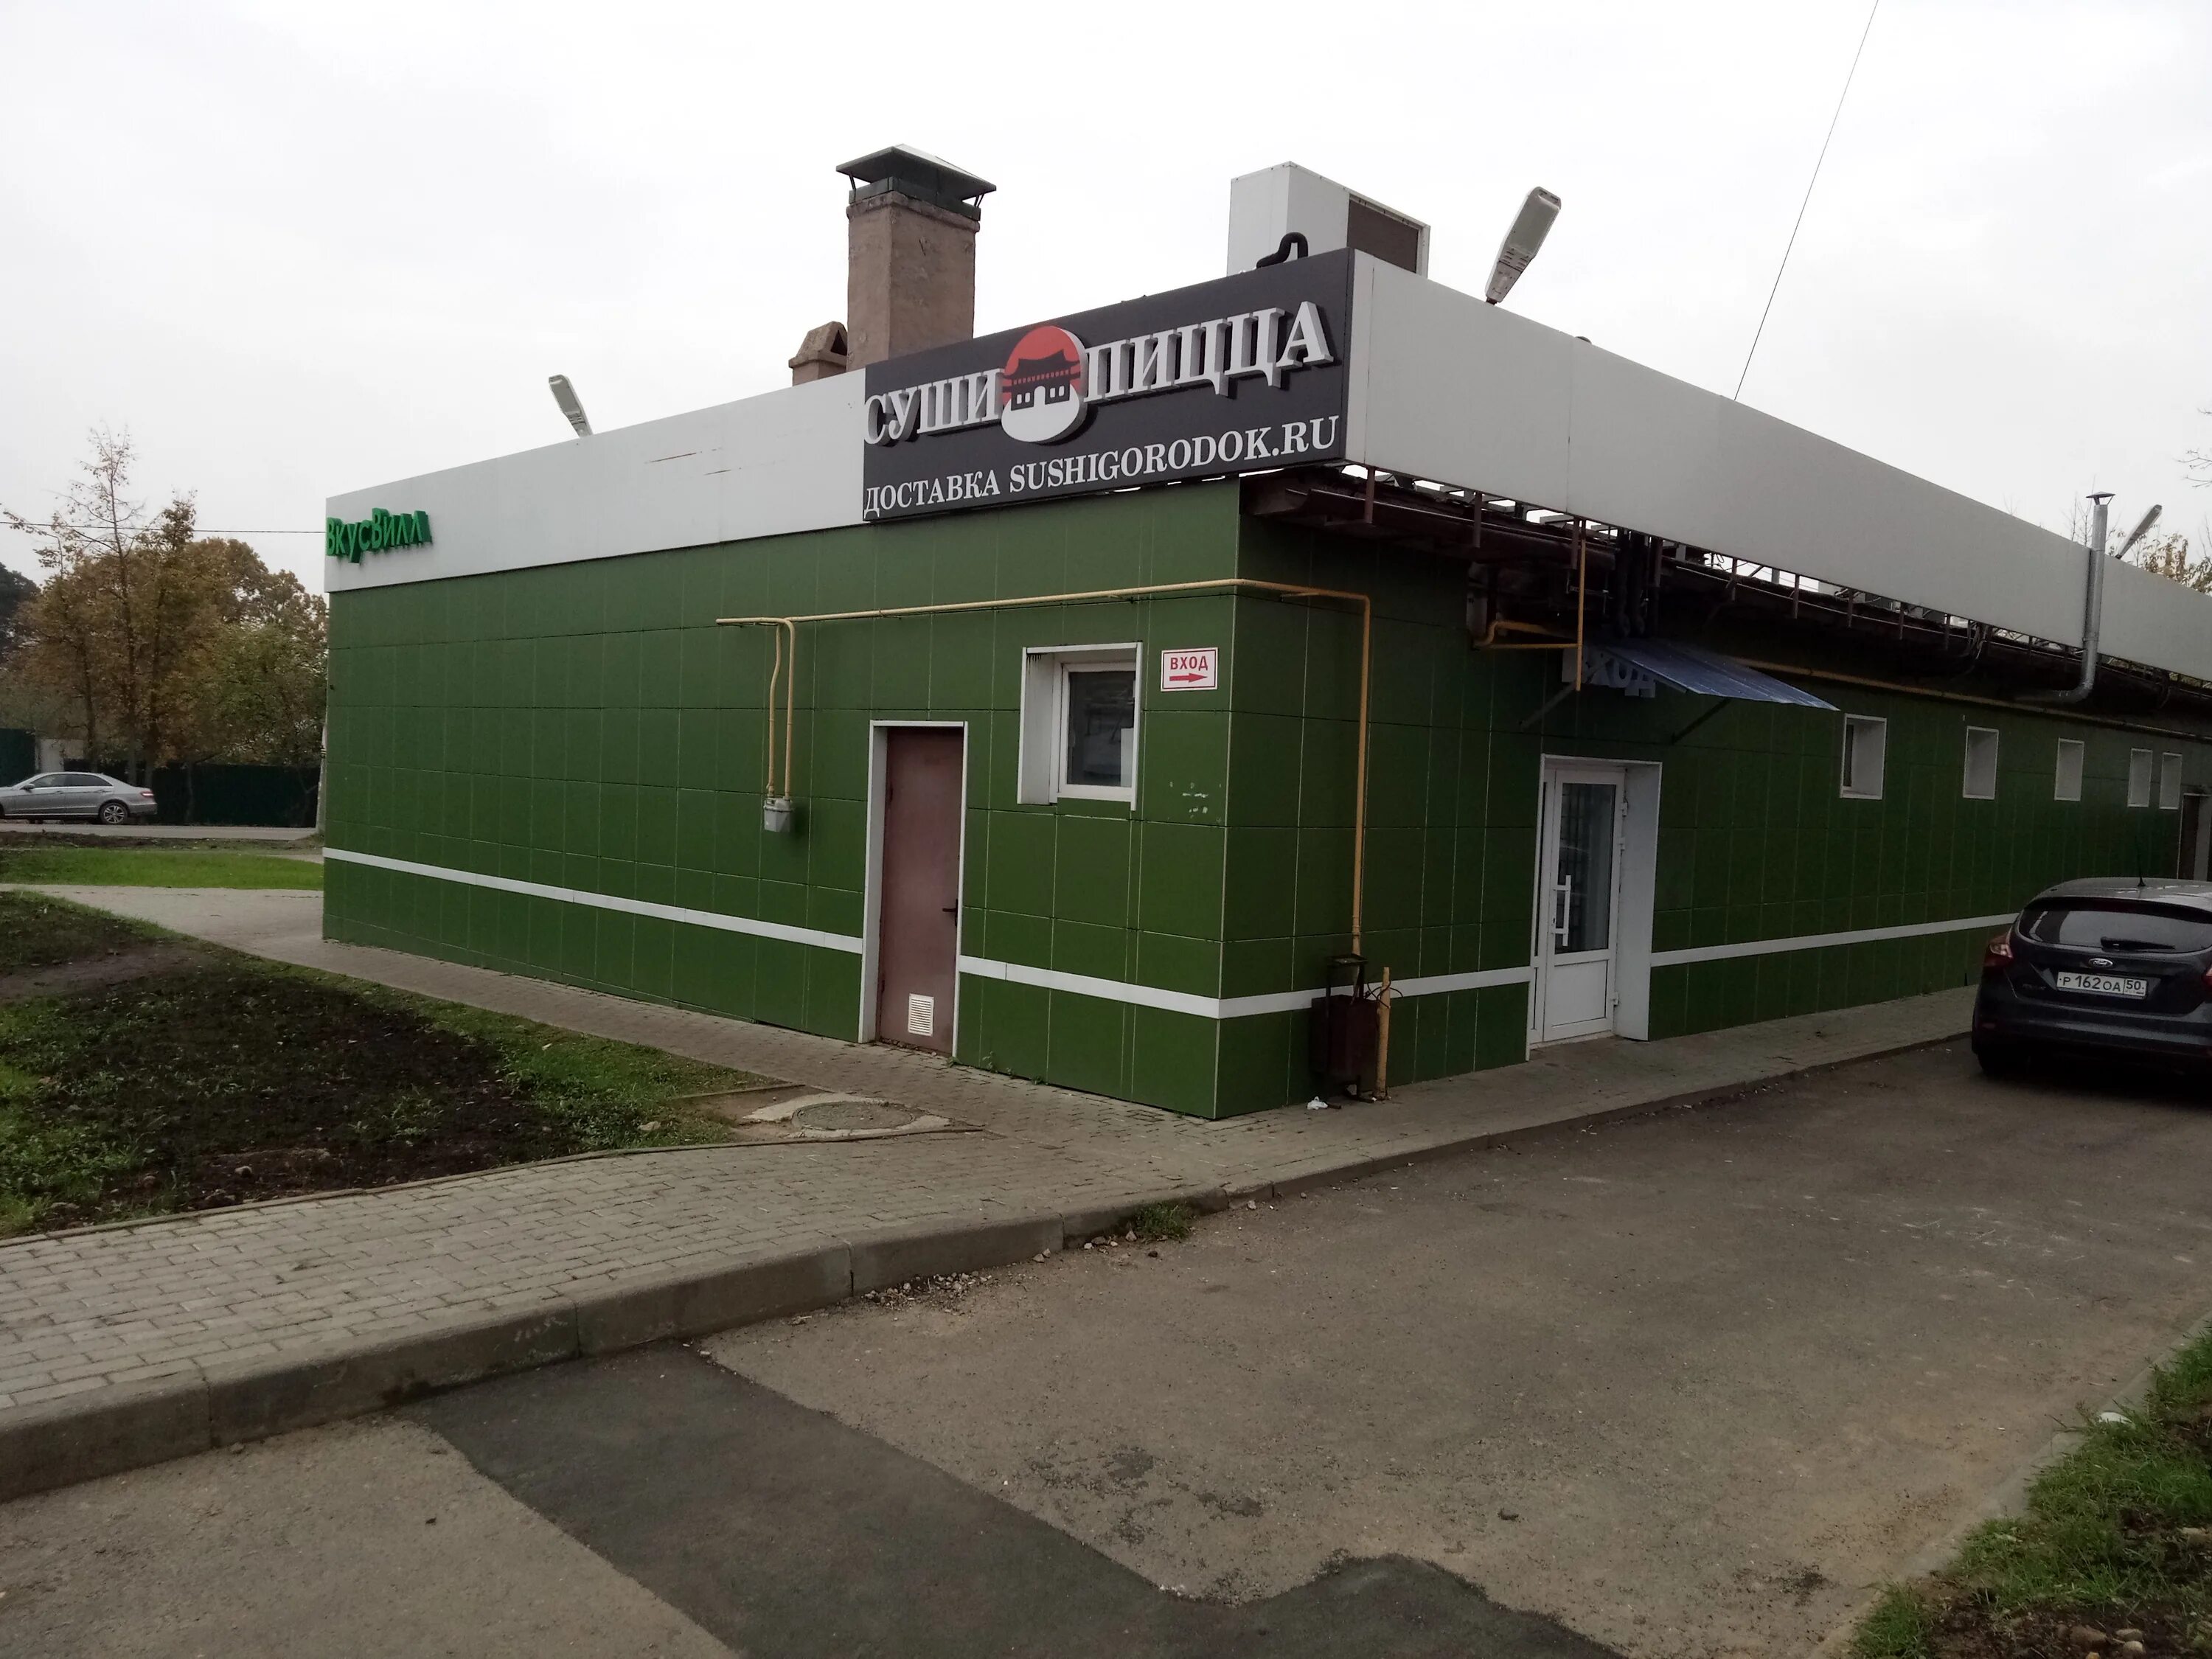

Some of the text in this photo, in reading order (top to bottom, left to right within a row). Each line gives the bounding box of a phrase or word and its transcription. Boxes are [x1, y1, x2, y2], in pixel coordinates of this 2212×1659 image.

[864, 301, 1334, 445] СУШИ ПИЦЦА
[864, 415, 1340, 518] ДОСТАВКА SUSHIGORODOK.RU
[1170, 655, 1208, 671] ВХОД
